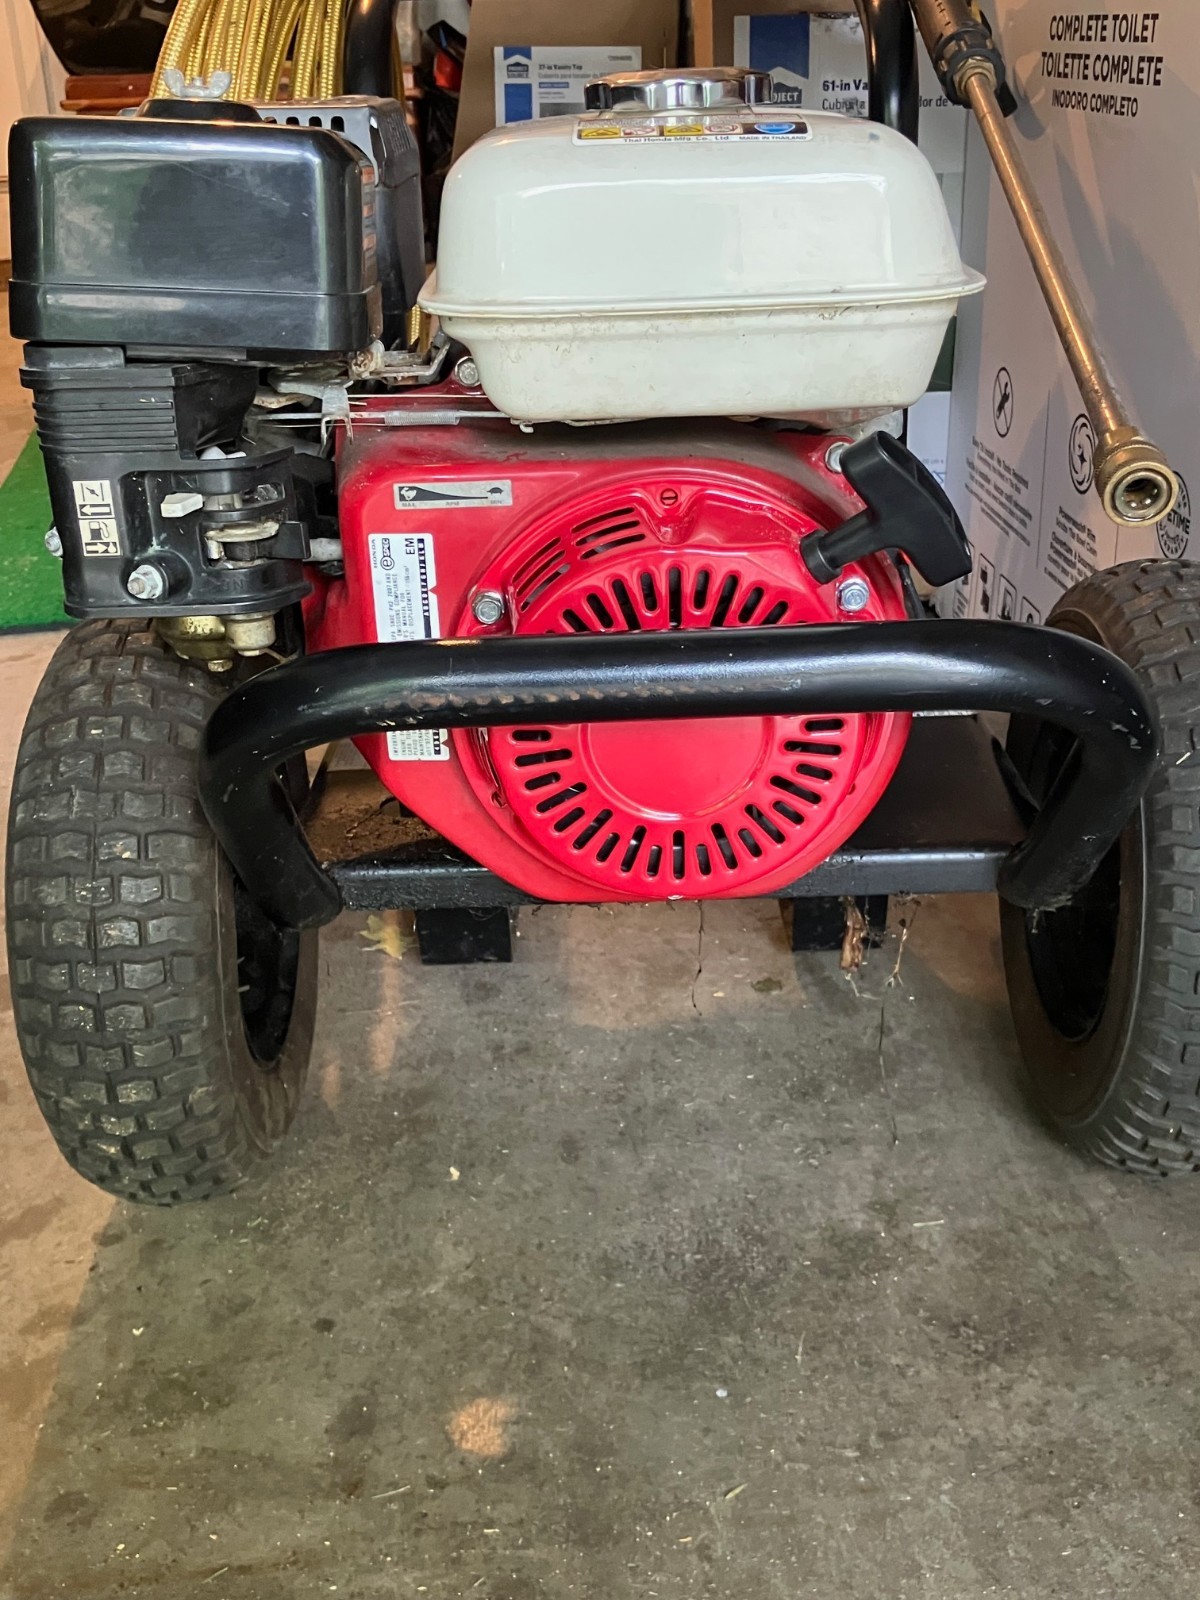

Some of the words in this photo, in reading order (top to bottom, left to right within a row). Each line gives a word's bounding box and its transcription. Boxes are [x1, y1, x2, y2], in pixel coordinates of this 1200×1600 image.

[1049, 14, 1108, 42] COMPLETE
[1112, 13, 1159, 43] TOILET
[1041, 51, 1090, 80] TOILETTE
[1093, 54, 1163, 86] COMPLETE
[822, 80, 850, 92] 61-in
[853, 79, 868, 91] Va
[936, 96, 948, 106] de
[1052, 88, 1088, 111] INODORO
[1090, 93, 1138, 117] COMPLETO
[1166, 509, 1190, 535] ETIME
[382, 538, 391, 556] SPEC
[405, 538, 415, 554] EM
[405, 589, 414, 626] DISPLACEMENT
